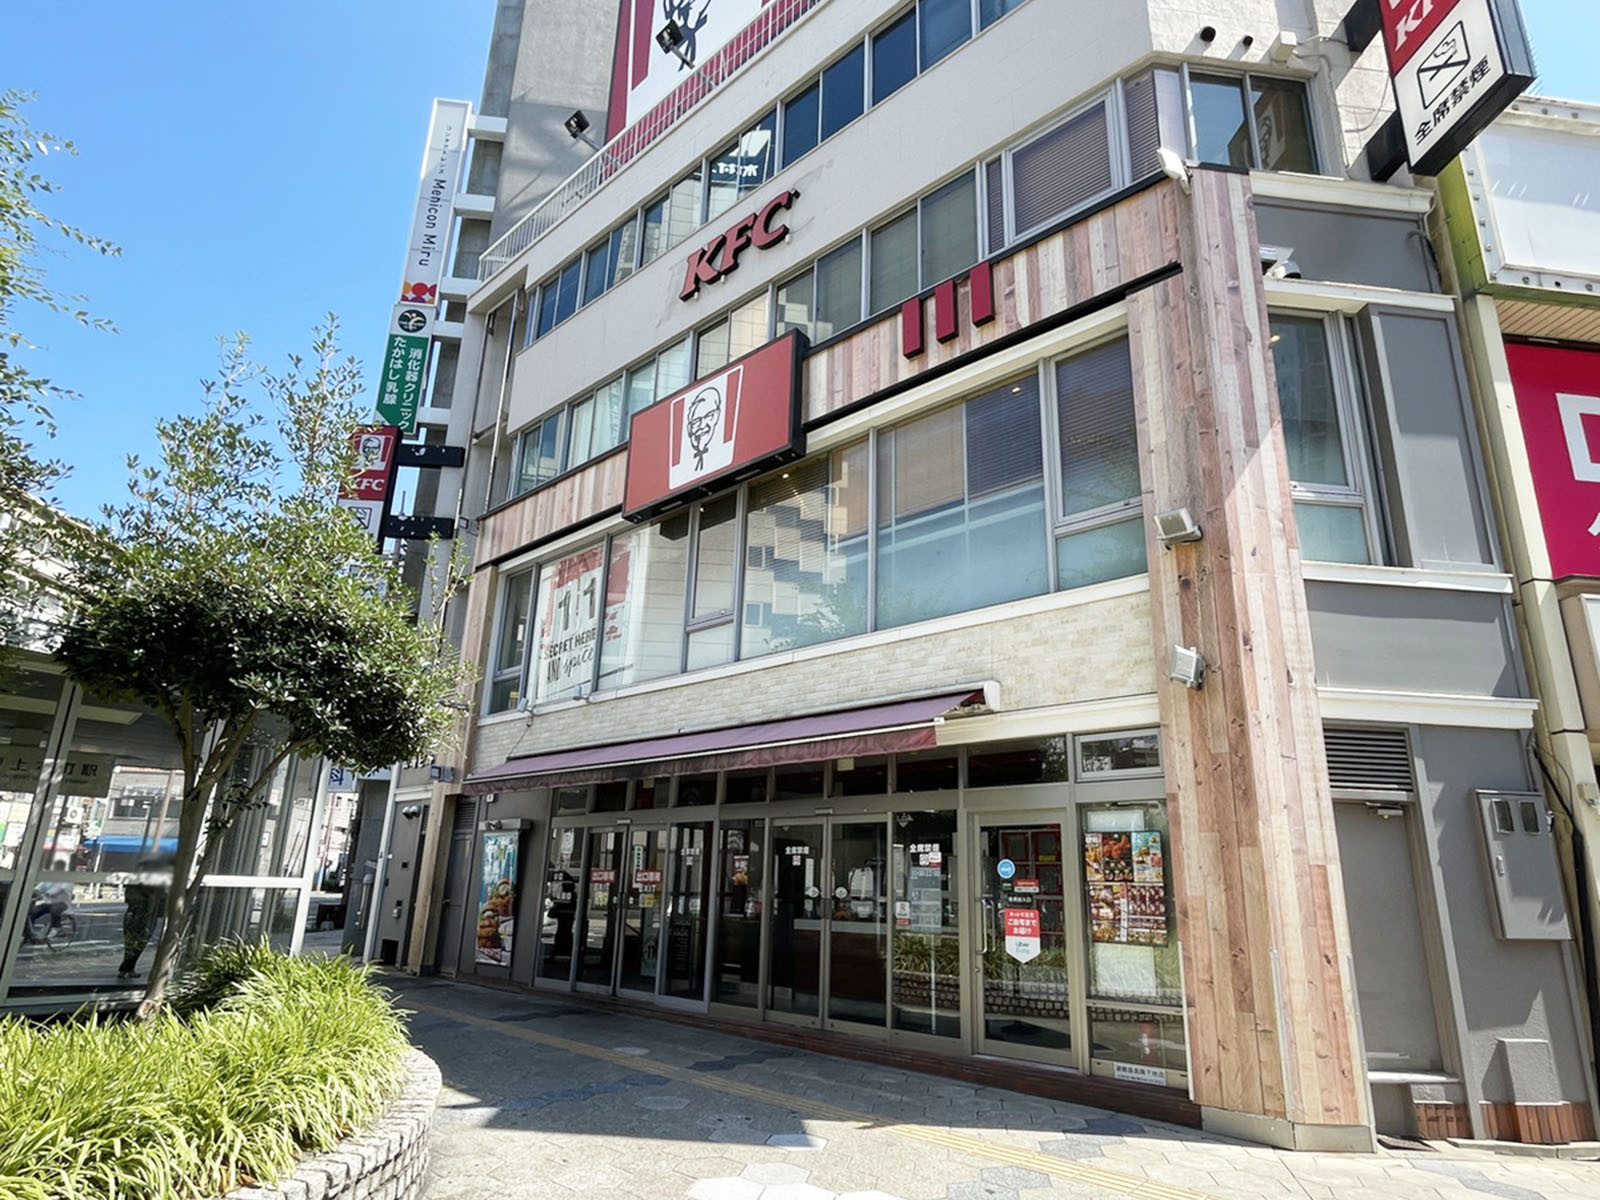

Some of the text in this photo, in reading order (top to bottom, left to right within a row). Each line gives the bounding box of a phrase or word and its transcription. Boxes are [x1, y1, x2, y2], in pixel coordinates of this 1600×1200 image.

[1415, 55, 1491, 146] 全席禁煙
[425, 179, 447, 229] Menicon
[418, 234, 437, 266] Miru
[679, 188, 800, 301] KFC
[382, 337, 406, 405] たかはし乳腺
[398, 347, 423, 430] 消化器クリニック
